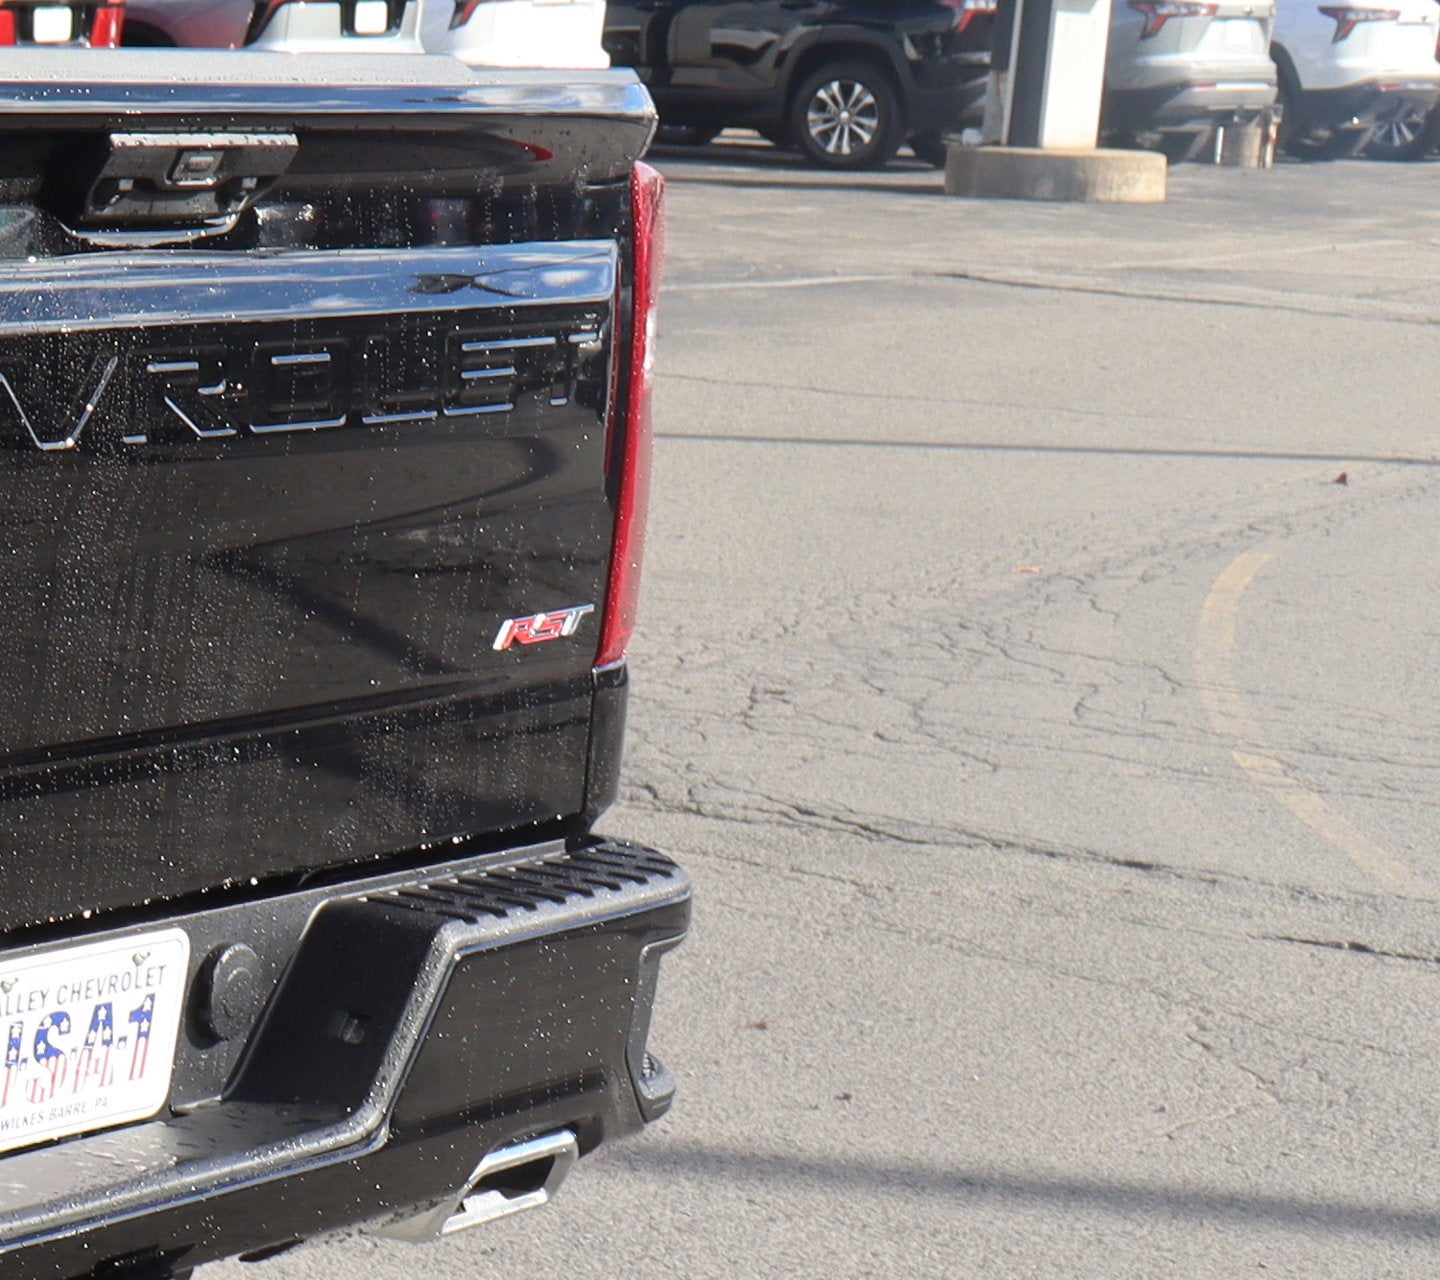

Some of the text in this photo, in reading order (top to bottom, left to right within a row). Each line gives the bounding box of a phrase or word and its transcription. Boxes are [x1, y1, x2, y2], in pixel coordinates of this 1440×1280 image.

[492, 603, 595, 651] RST
[56, 965, 167, 1006] CHEVROLET
[0, 1095, 109, 1132] WILKES BARRE PA
